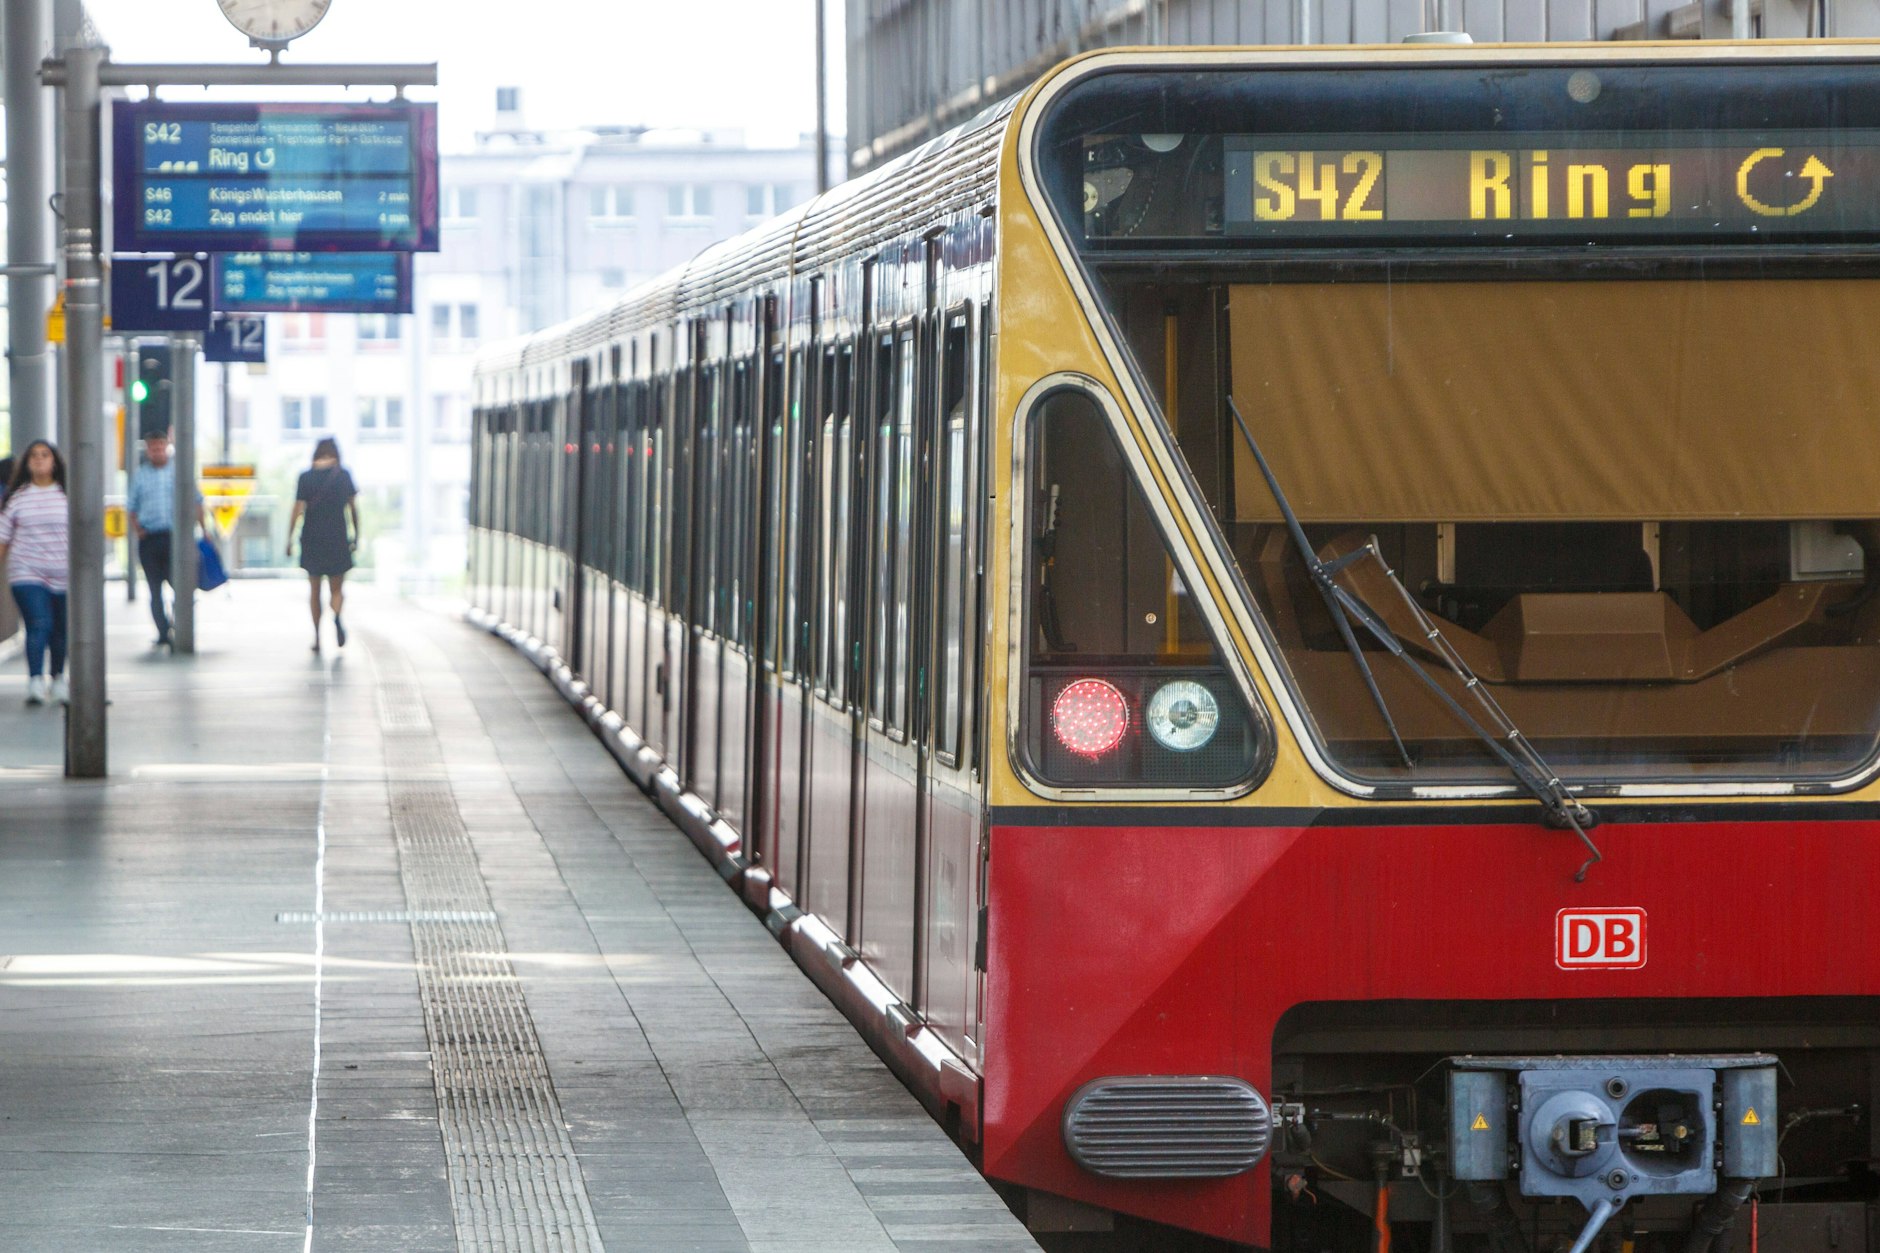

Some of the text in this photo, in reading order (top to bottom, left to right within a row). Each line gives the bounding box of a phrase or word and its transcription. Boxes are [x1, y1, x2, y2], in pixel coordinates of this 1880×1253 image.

[145, 122, 181, 142] S42
[209, 148, 248, 173] Ring
[145, 187, 172, 202] S46
[1253, 150, 1670, 220] S42 Ring
[145, 208, 172, 223] S42
[209, 208, 235, 227] Zug
[238, 209, 274, 223] endet
[146, 259, 204, 309] 12
[225, 317, 263, 350] 12
[1569, 918, 1635, 958] DB
